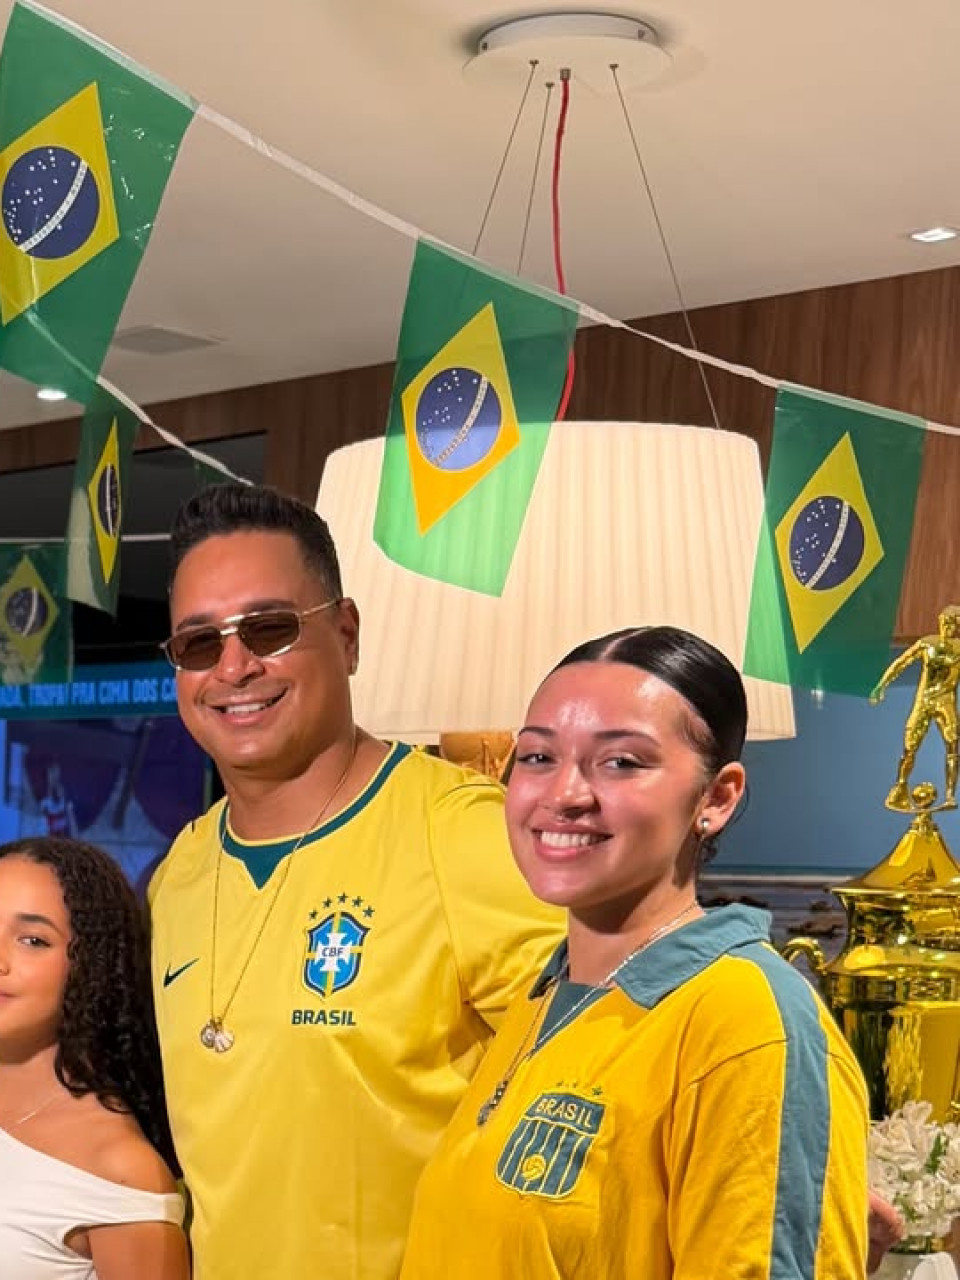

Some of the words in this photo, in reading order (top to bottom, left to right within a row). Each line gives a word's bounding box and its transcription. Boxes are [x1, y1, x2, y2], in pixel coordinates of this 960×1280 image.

[133, 679, 157, 702] DOS
[321, 946, 344, 957] CBF
[291, 1009, 357, 1026] BRASIL
[535, 1098, 592, 1128] BRASIL
